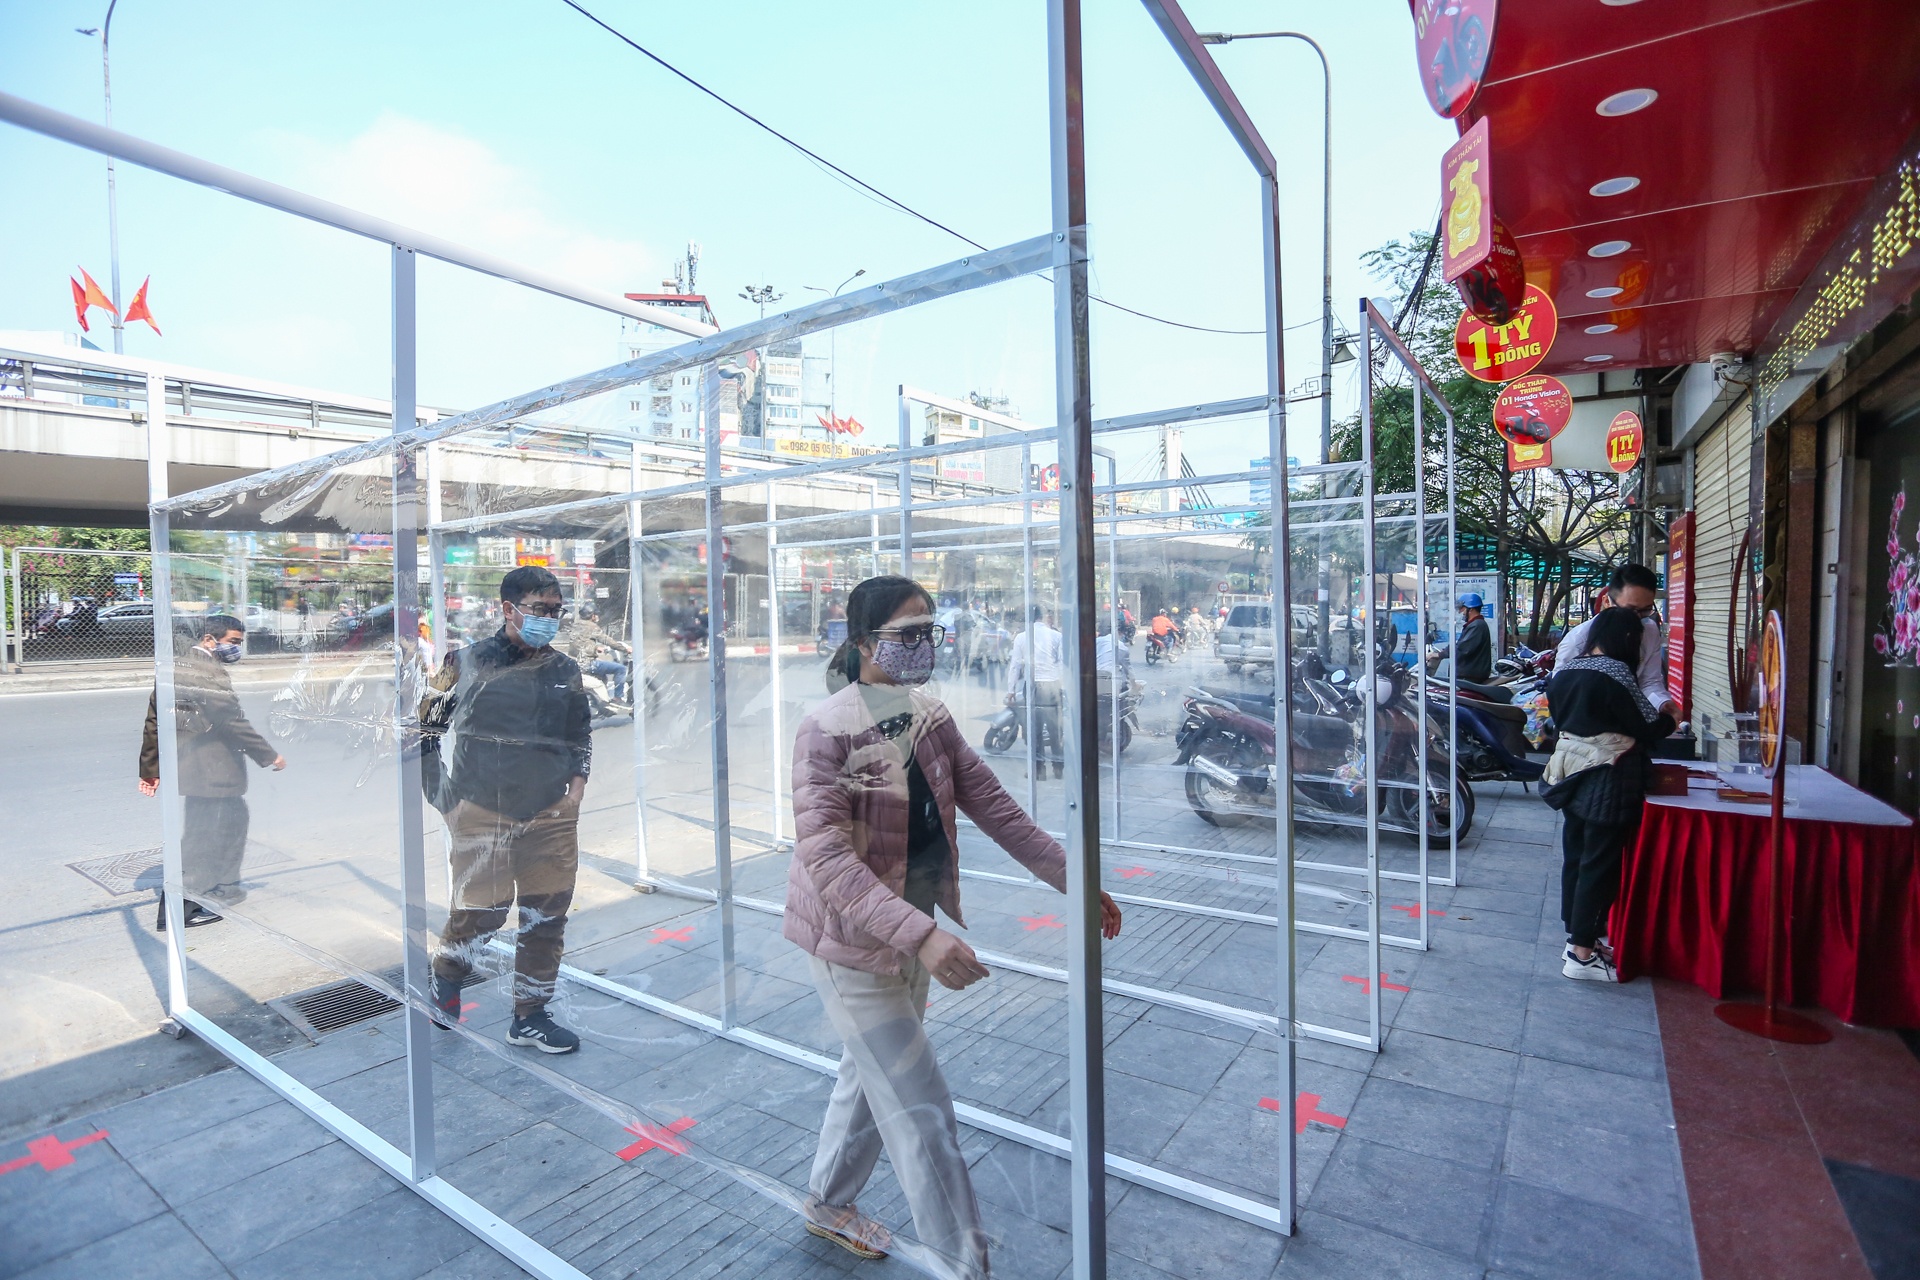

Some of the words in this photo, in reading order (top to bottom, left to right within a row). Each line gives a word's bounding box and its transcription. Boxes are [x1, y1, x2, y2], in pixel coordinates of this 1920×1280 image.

[1418, 5, 1429, 40] 01
[1497, 244, 1516, 256] Vision
[1493, 310, 1533, 346] TỶ
[1468, 327, 1492, 371] 1
[1494, 342, 1541, 366] ĐỒNG
[1502, 396, 1512, 406] 01
[1514, 392, 1538, 403] Honda
[1539, 389, 1561, 398] Vision
[1611, 436, 1618, 464] 1
[1620, 430, 1635, 451] TỶ
